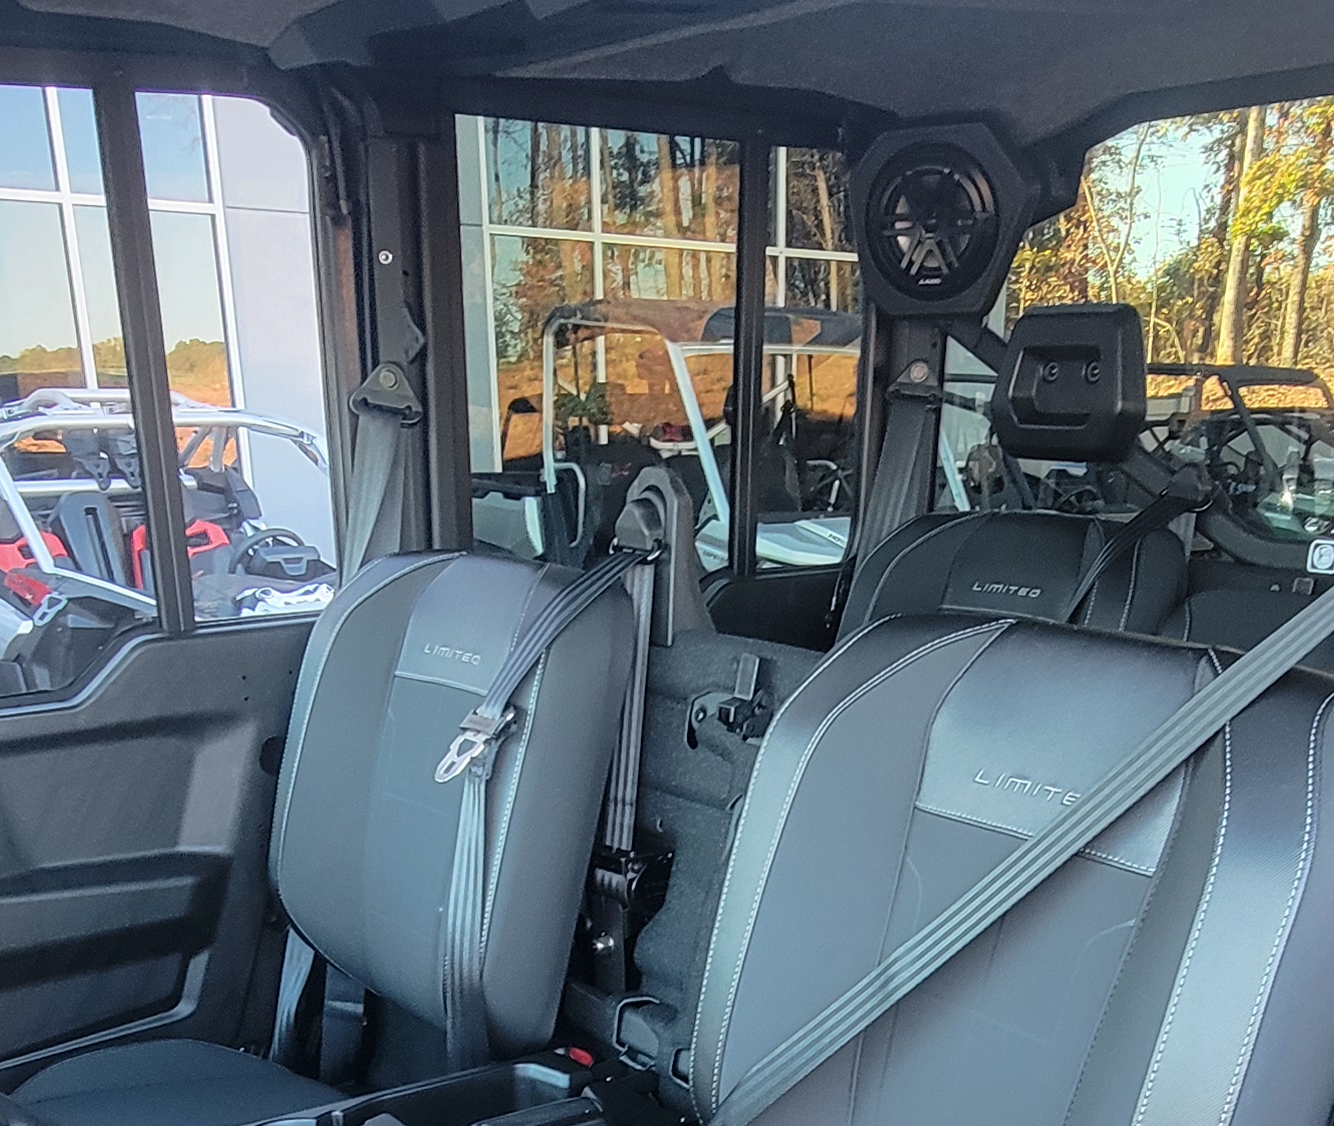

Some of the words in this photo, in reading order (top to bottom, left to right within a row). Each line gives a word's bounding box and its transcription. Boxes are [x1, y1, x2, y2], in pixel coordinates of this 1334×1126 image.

[972, 582, 1041, 598] LIMITED
[424, 644, 481, 665] LIMITED
[974, 768, 1082, 806] LIMITE
